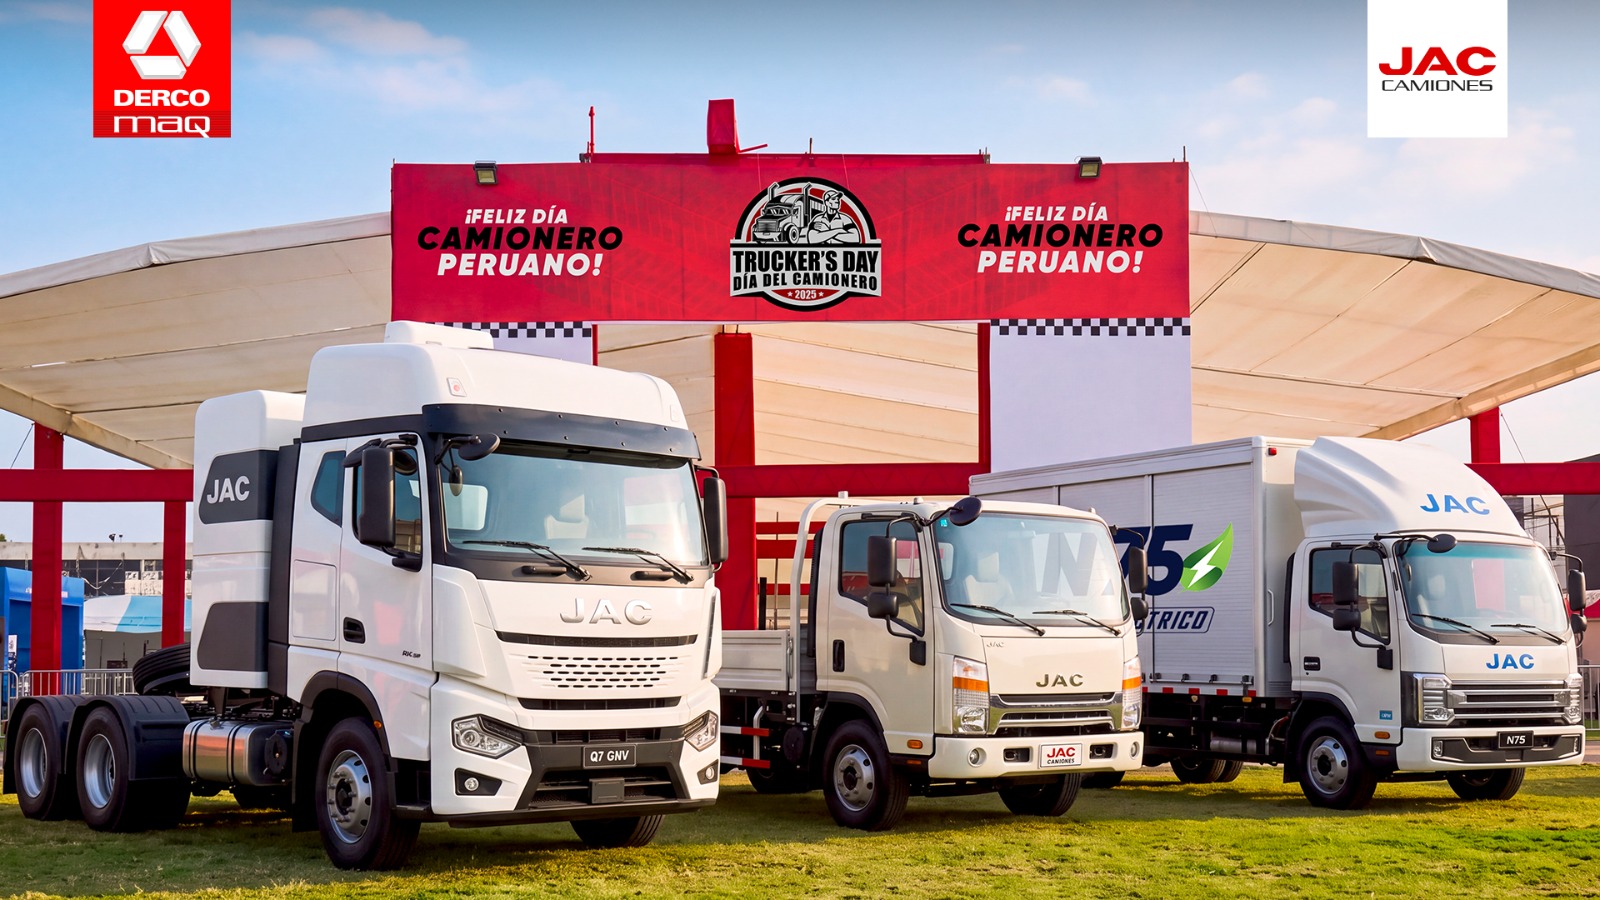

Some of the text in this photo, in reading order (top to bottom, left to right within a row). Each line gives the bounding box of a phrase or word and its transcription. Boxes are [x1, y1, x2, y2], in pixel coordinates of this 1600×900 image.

[465, 205, 568, 224] ¡FELIZ DÍA
[1005, 202, 1108, 222] ¡FELIZ DÍA
[417, 226, 623, 250] CAMIONERO
[957, 223, 1163, 248] CAMIONERO
[437, 253, 603, 276] PERUANO!
[843, 250, 879, 273] DAY
[977, 250, 1144, 274] PERUANO!
[733, 272, 878, 291] DÍA DEL CAMIONERO
[795, 289, 817, 300] 2025
[206, 475, 250, 504] JAC
[1420, 493, 1491, 516] JAC
[560, 597, 653, 626] JAC
[1486, 653, 1535, 670] JAC
[1036, 673, 1084, 688] JAC
[1506, 734, 1526, 745] N75
[590, 750, 630, 762] Q7 GNV
[1047, 747, 1076, 758] JAC
